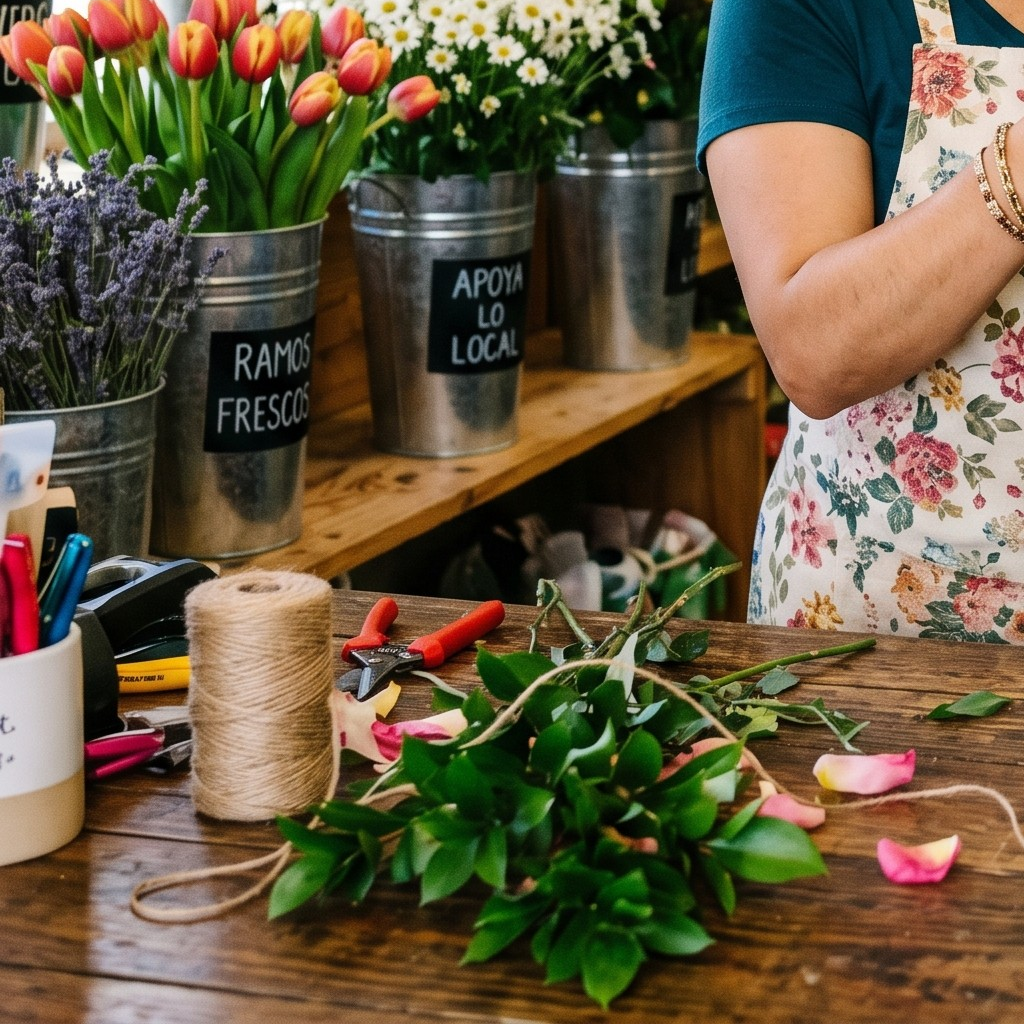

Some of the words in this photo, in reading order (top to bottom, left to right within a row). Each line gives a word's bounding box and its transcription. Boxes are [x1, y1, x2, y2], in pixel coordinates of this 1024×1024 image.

[452, 261, 523, 299] APOYA
[478, 302, 505, 329] LO
[234, 332, 311, 381] RAMOS
[451, 328, 519, 365] LOCAL
[217, 381, 310, 434] FRESCOS
